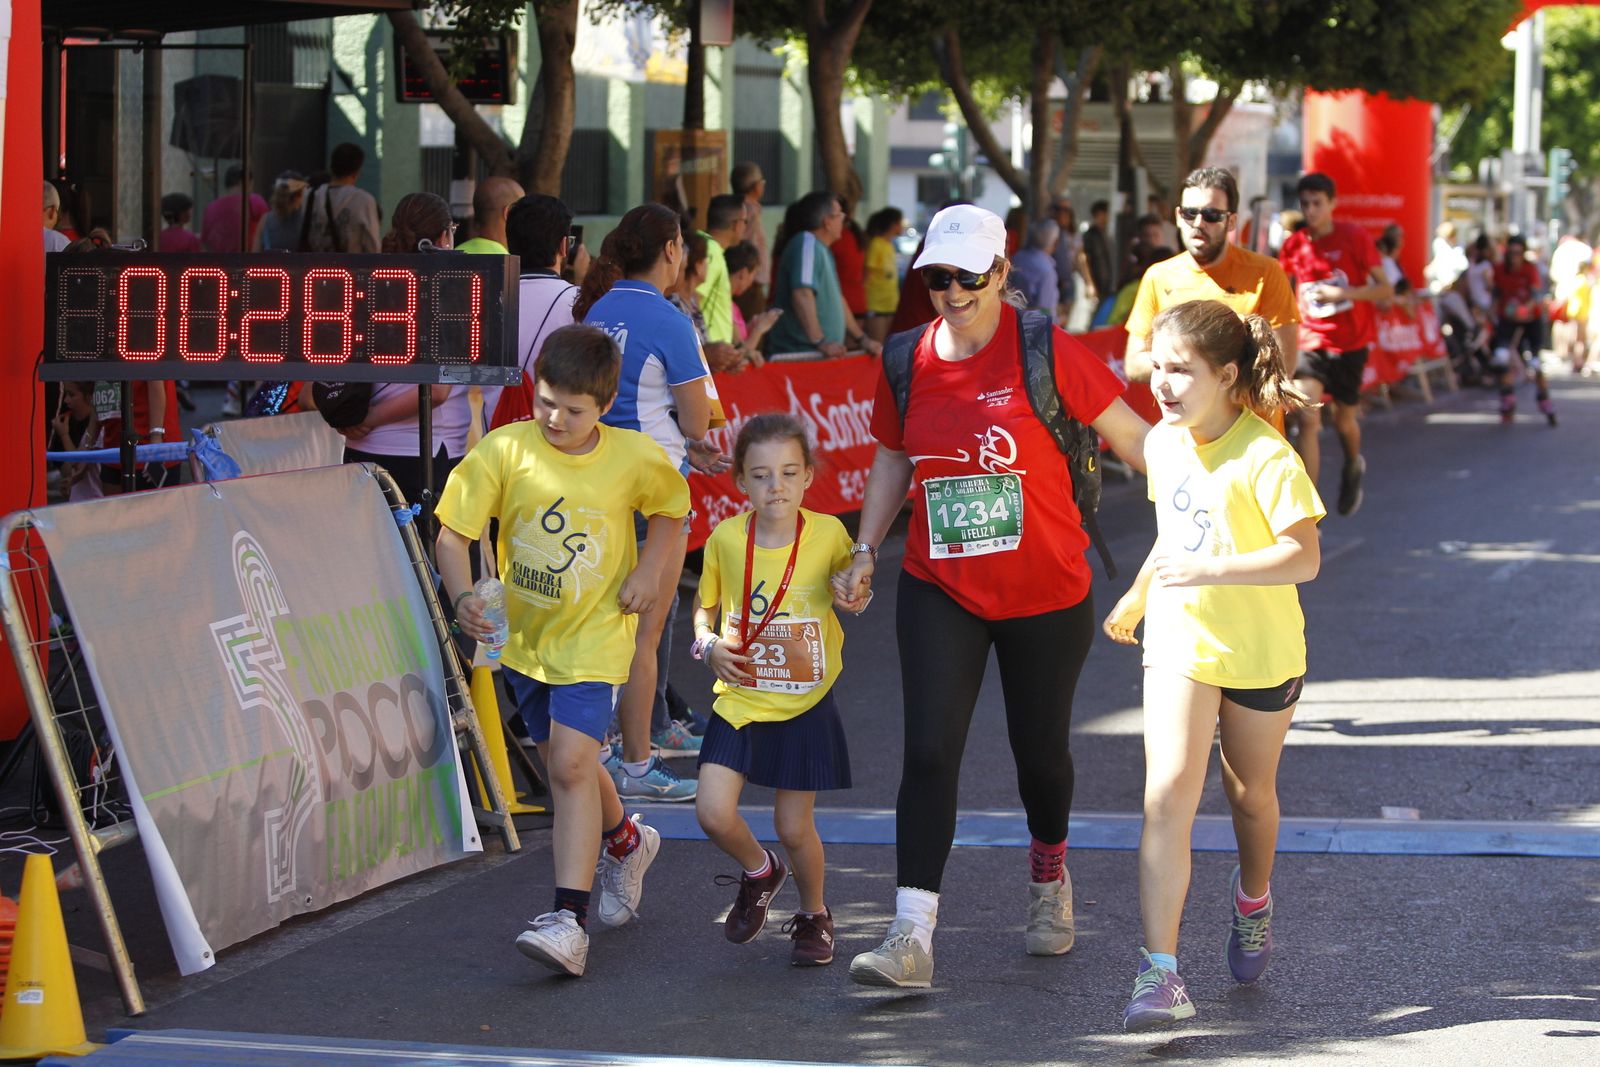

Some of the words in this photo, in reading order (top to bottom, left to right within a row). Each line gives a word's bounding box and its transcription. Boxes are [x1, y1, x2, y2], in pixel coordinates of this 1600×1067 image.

[986, 386, 1014, 399] Santander
[955, 478, 990, 489] CARRERA
[955, 484, 991, 495] SOLIDARIA
[541, 496, 565, 534] 6
[937, 497, 1010, 529] 1234
[967, 527, 989, 540] FELIZ
[512, 561, 563, 589] CARRERA
[512, 571, 561, 599] SOLIDARIA
[750, 580, 769, 616] 6
[749, 642, 787, 666] 23
[756, 667, 791, 679] MARTINA
